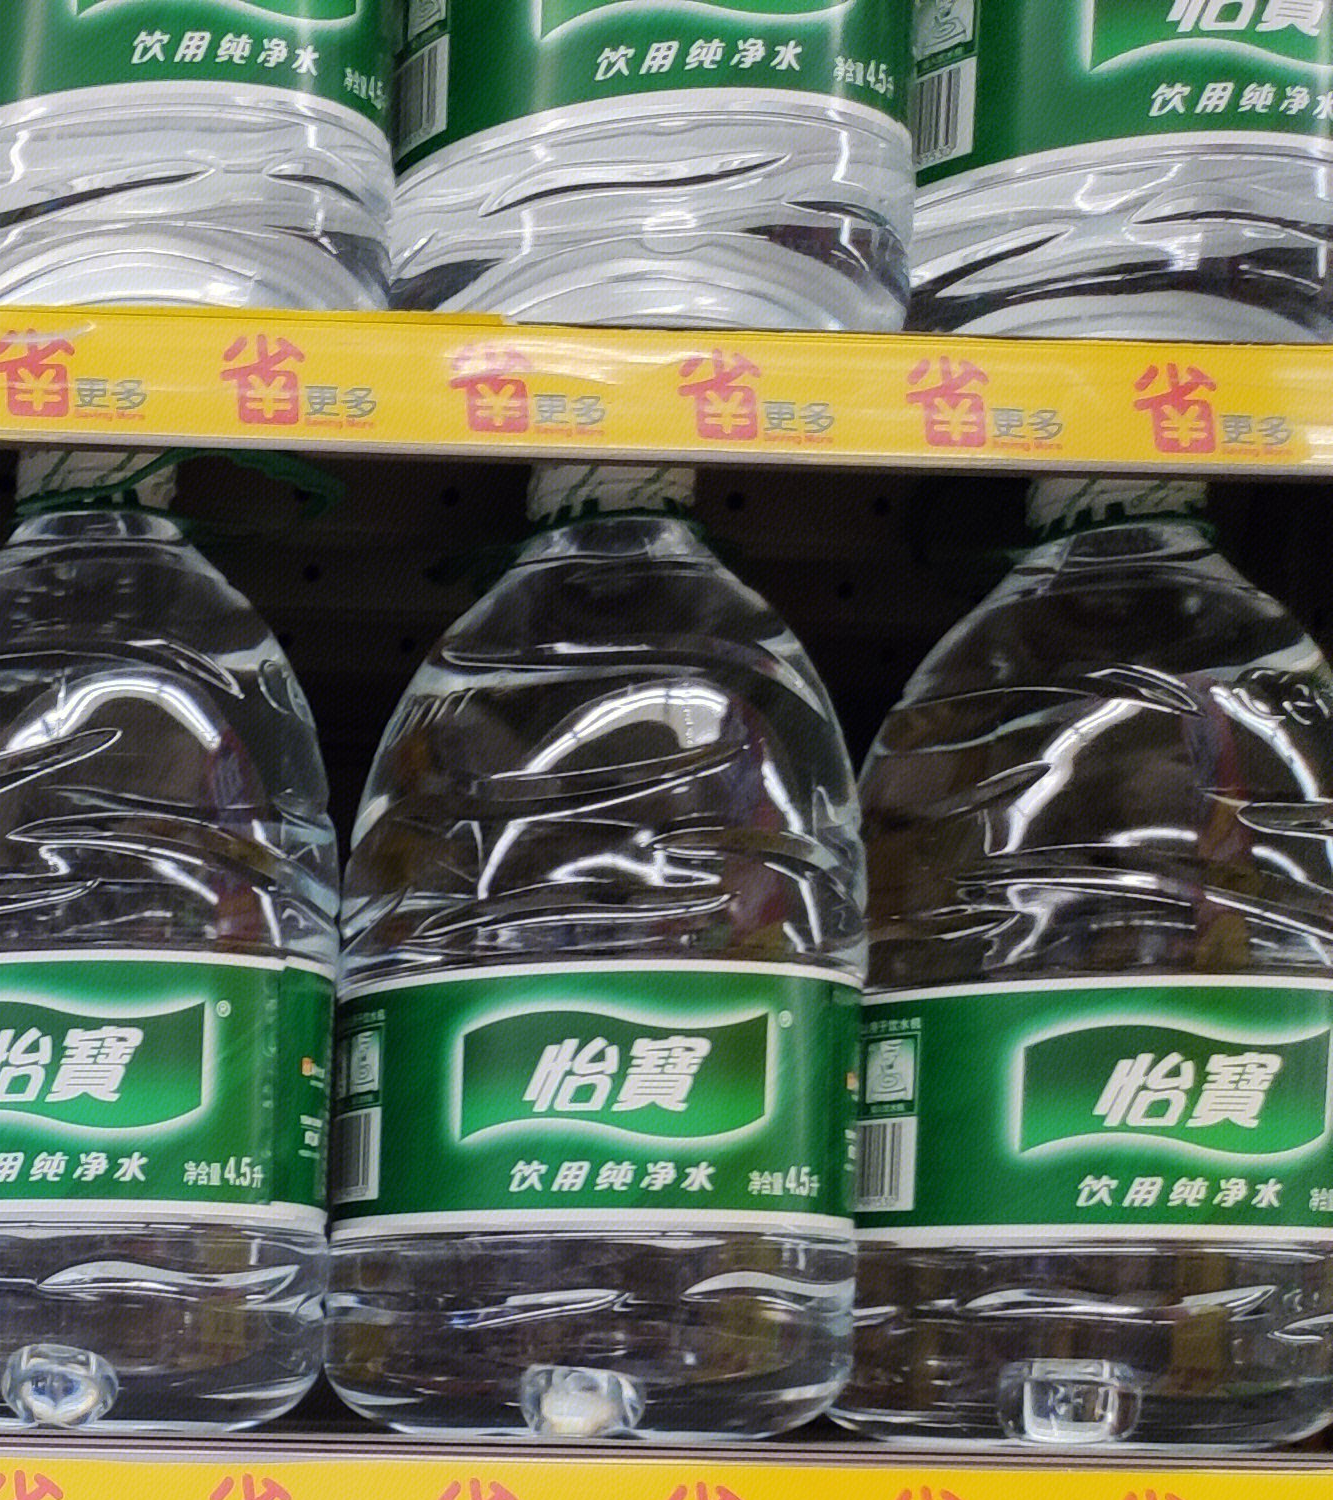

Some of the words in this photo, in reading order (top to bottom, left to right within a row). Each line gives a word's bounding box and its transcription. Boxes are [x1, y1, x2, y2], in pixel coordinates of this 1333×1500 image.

[130, 30, 320, 77] 饮用纯净水
[593, 38, 803, 82] 饮用纯净水
[221, 336, 303, 424] 省
[303, 385, 377, 417] 更多
[1136, 365, 1215, 453] 省
[1218, 414, 1294, 446] 更多
[182, 1156, 265, 1189] 净含量4.5升
[508, 1159, 718, 1194] 饮用纯净水
[1074, 1174, 1285, 1210] 饮用纯净水
